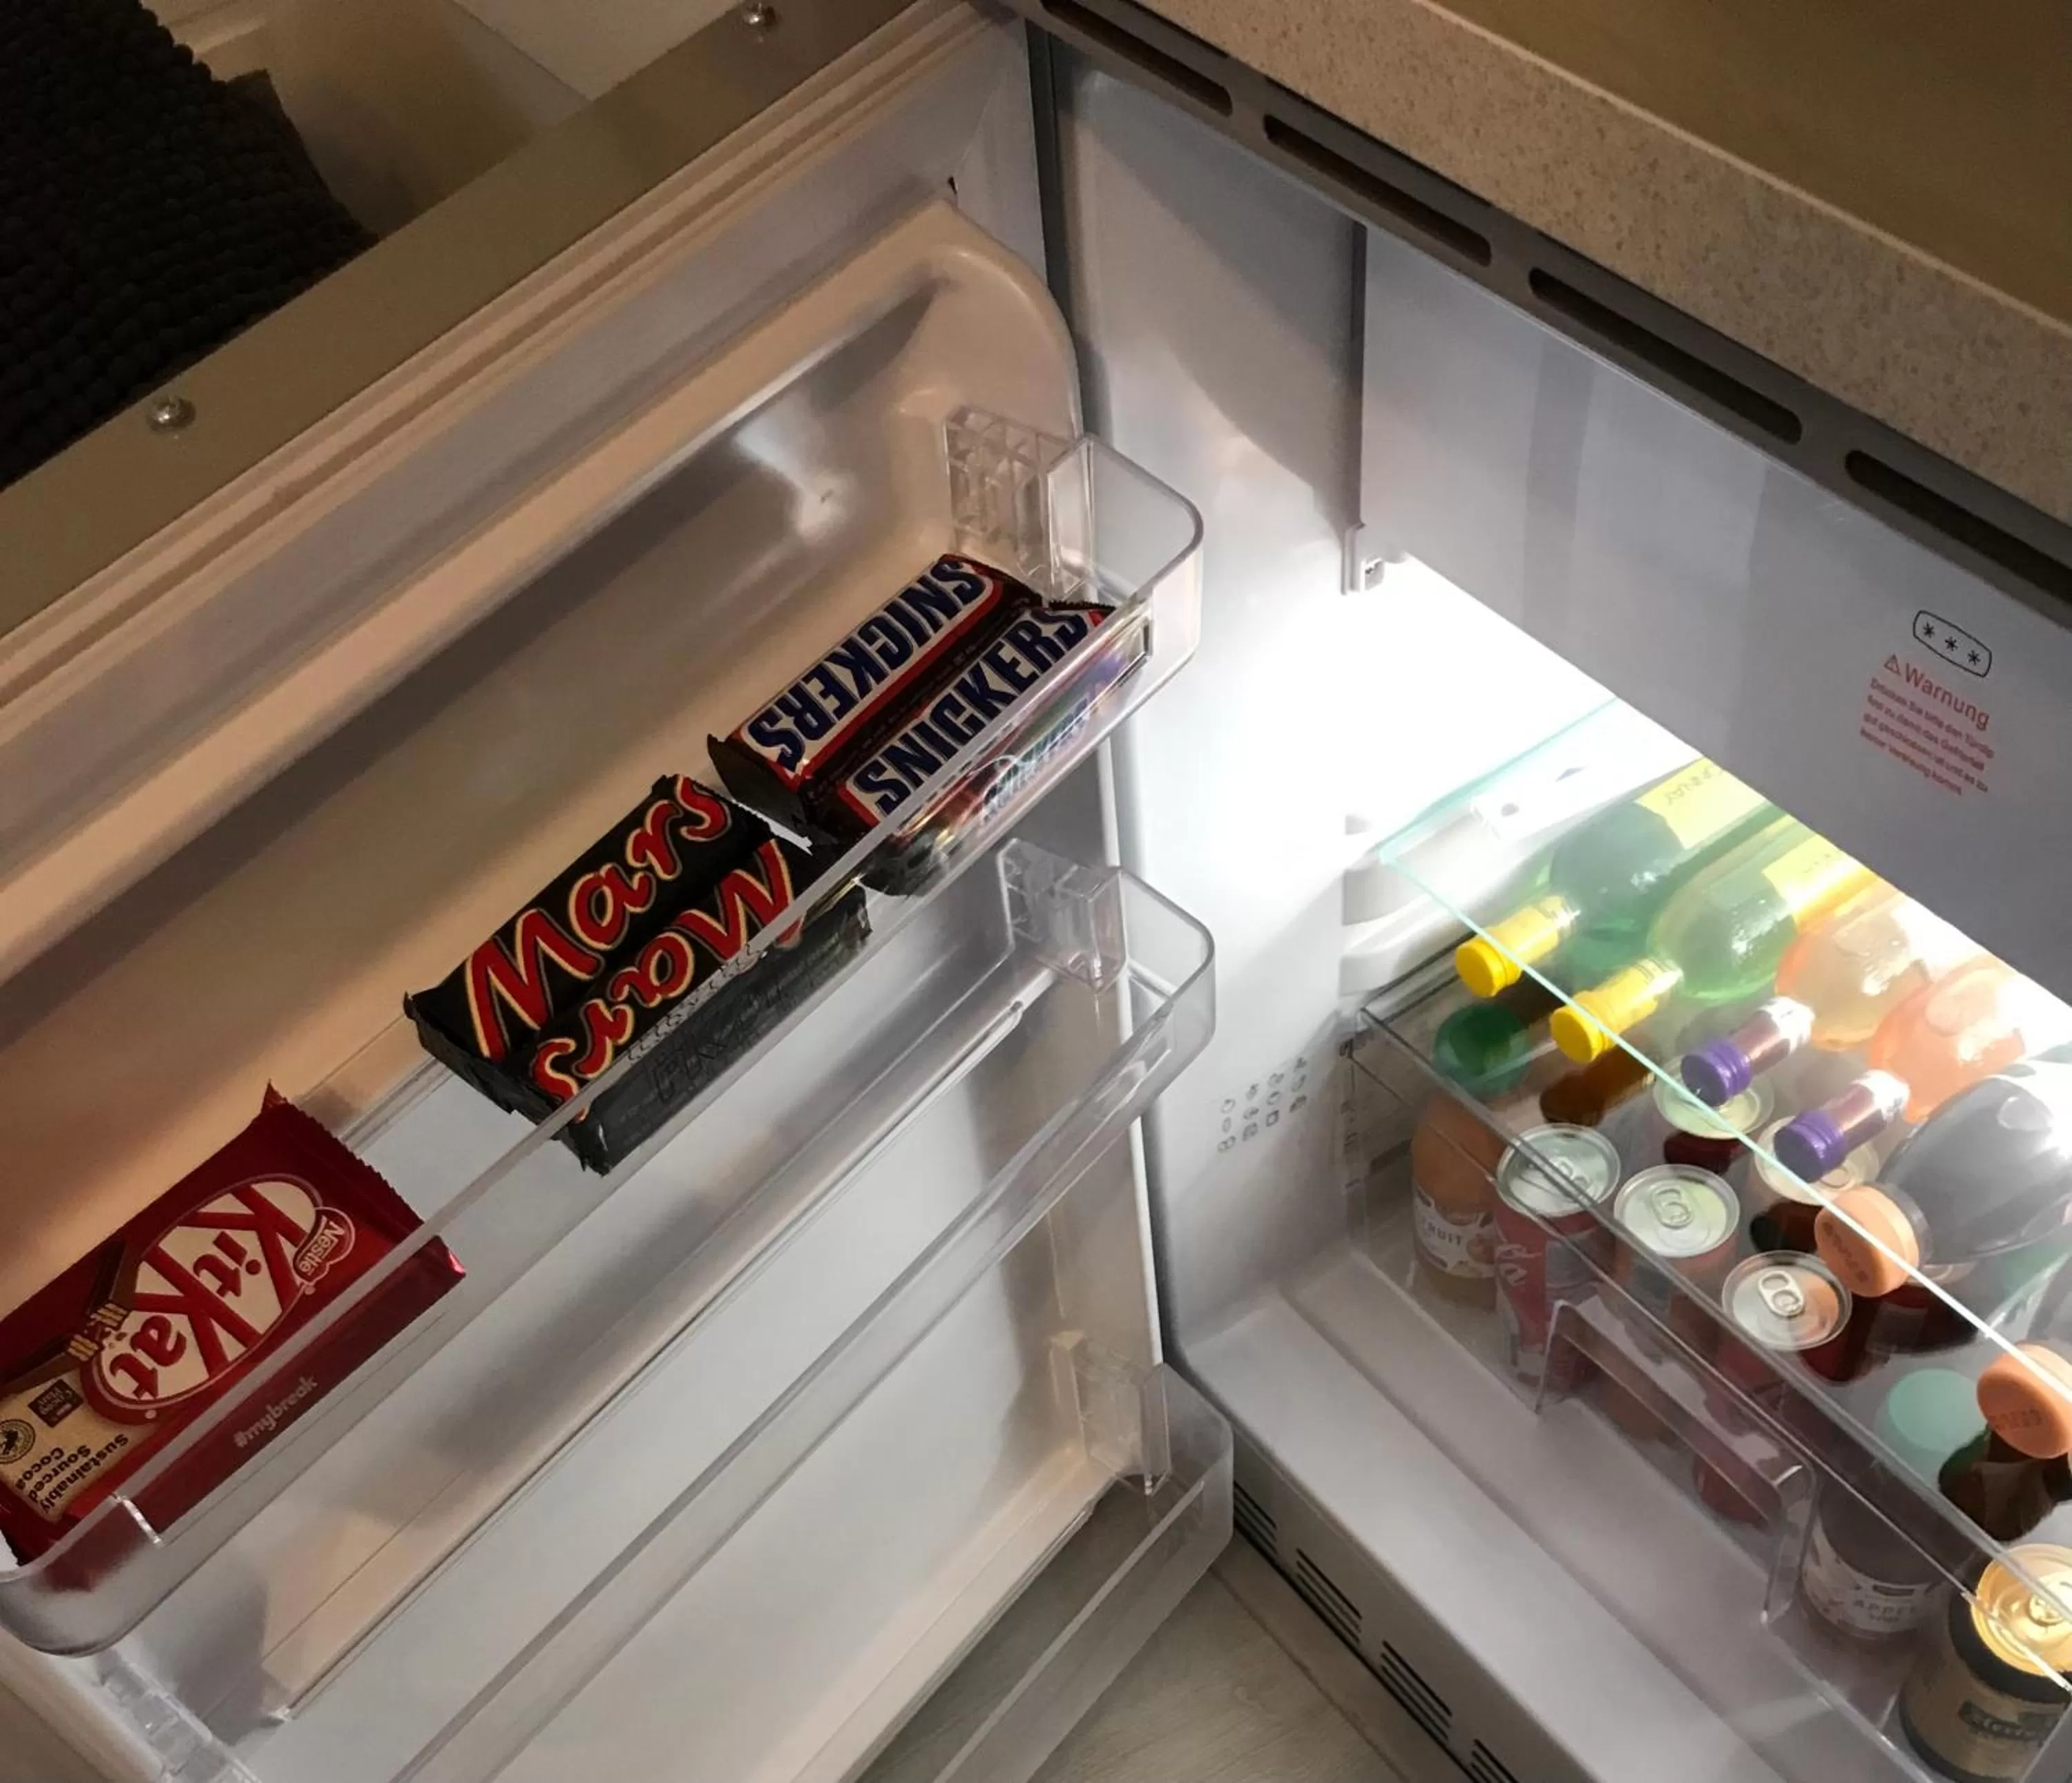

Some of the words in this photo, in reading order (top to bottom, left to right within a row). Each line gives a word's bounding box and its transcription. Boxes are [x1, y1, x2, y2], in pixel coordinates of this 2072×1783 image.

[747, 560, 986, 773] SNICKERS
[1906, 662, 1990, 731] Warnung
[853, 608, 1089, 816] SNICKERS
[465, 774, 731, 1061] Mars
[532, 838, 796, 1122] Mars
[298, 1220, 345, 1276] Nestlé
[108, 1184, 309, 1400] KitKat
[234, 1376, 318, 1447] #mybreak
[15, 1447, 64, 1490] Cocoa
[28, 1445, 91, 1503] Sourced
[40, 1434, 128, 1513] Sustainably
